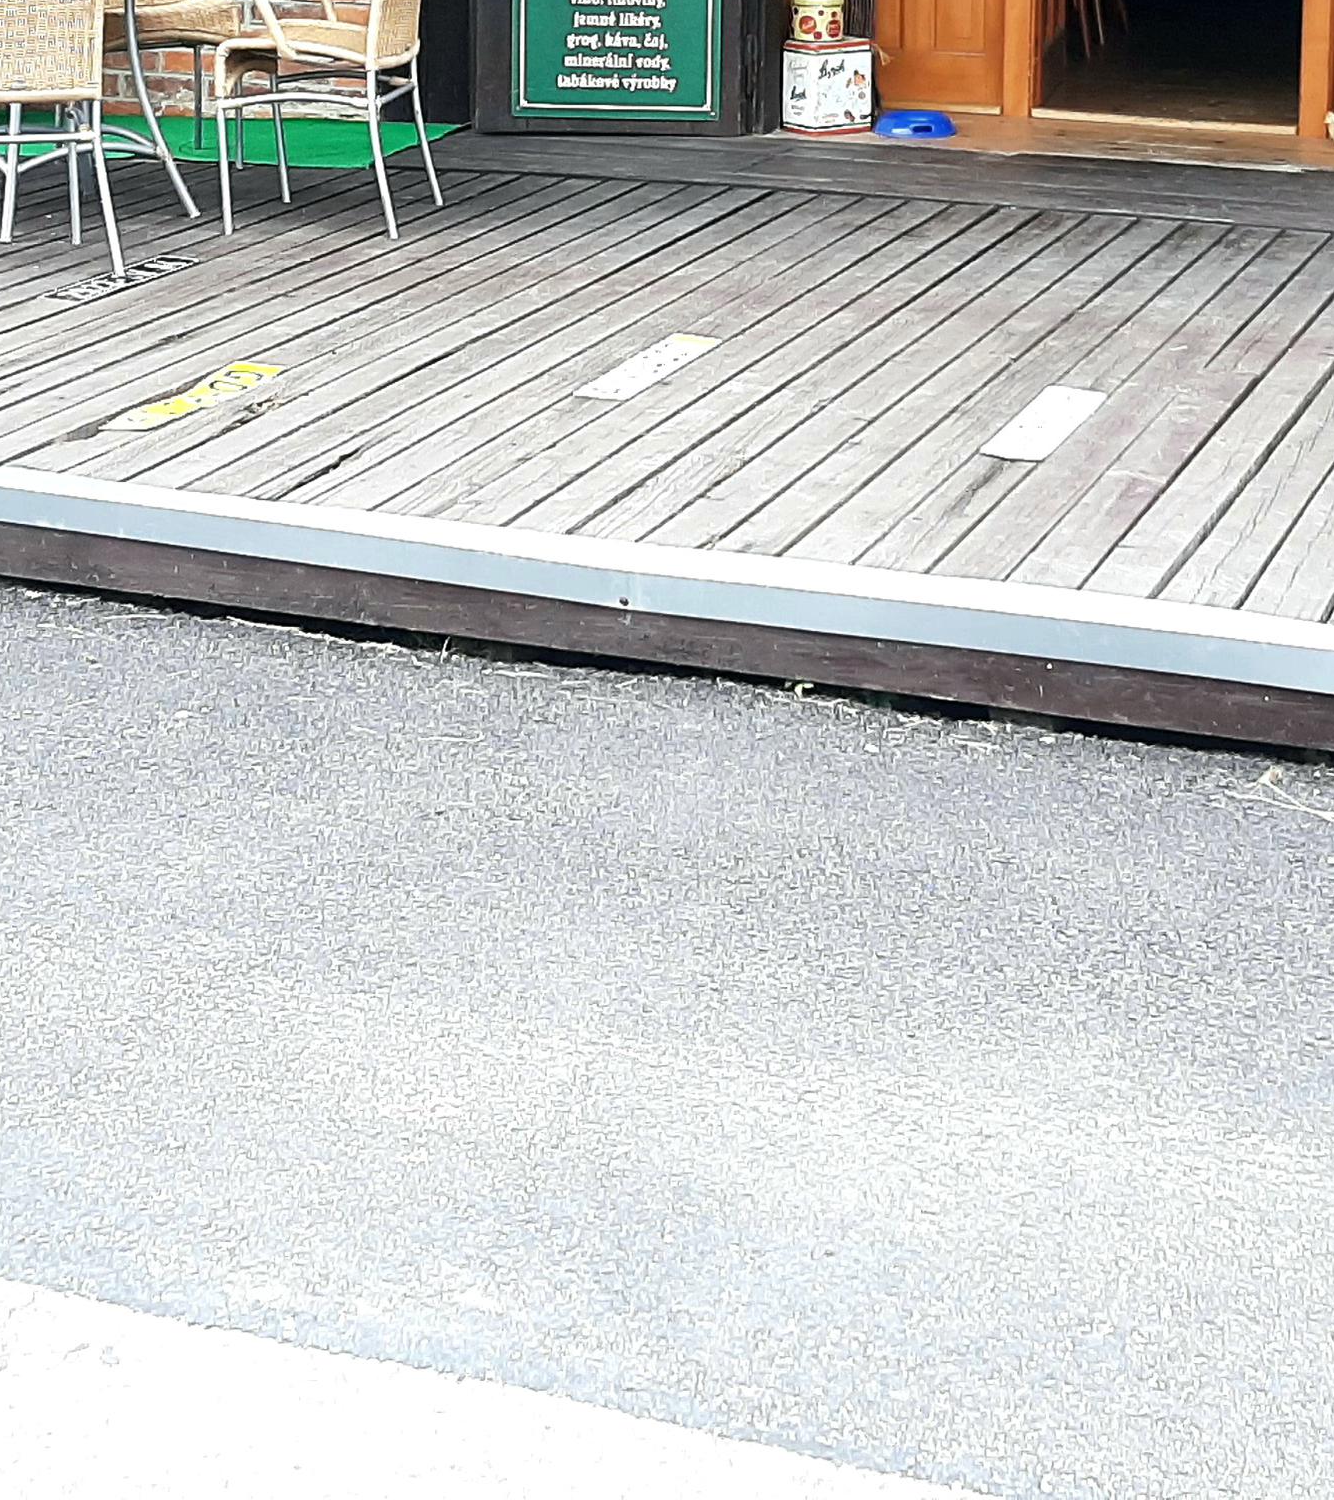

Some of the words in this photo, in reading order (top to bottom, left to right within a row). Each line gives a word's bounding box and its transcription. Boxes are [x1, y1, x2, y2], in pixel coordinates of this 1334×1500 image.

[604, 31, 642, 48] káva,
[564, 52, 633, 68] minerální
[557, 73, 619, 88] tabákové
[621, 73, 677, 92] výrobky
